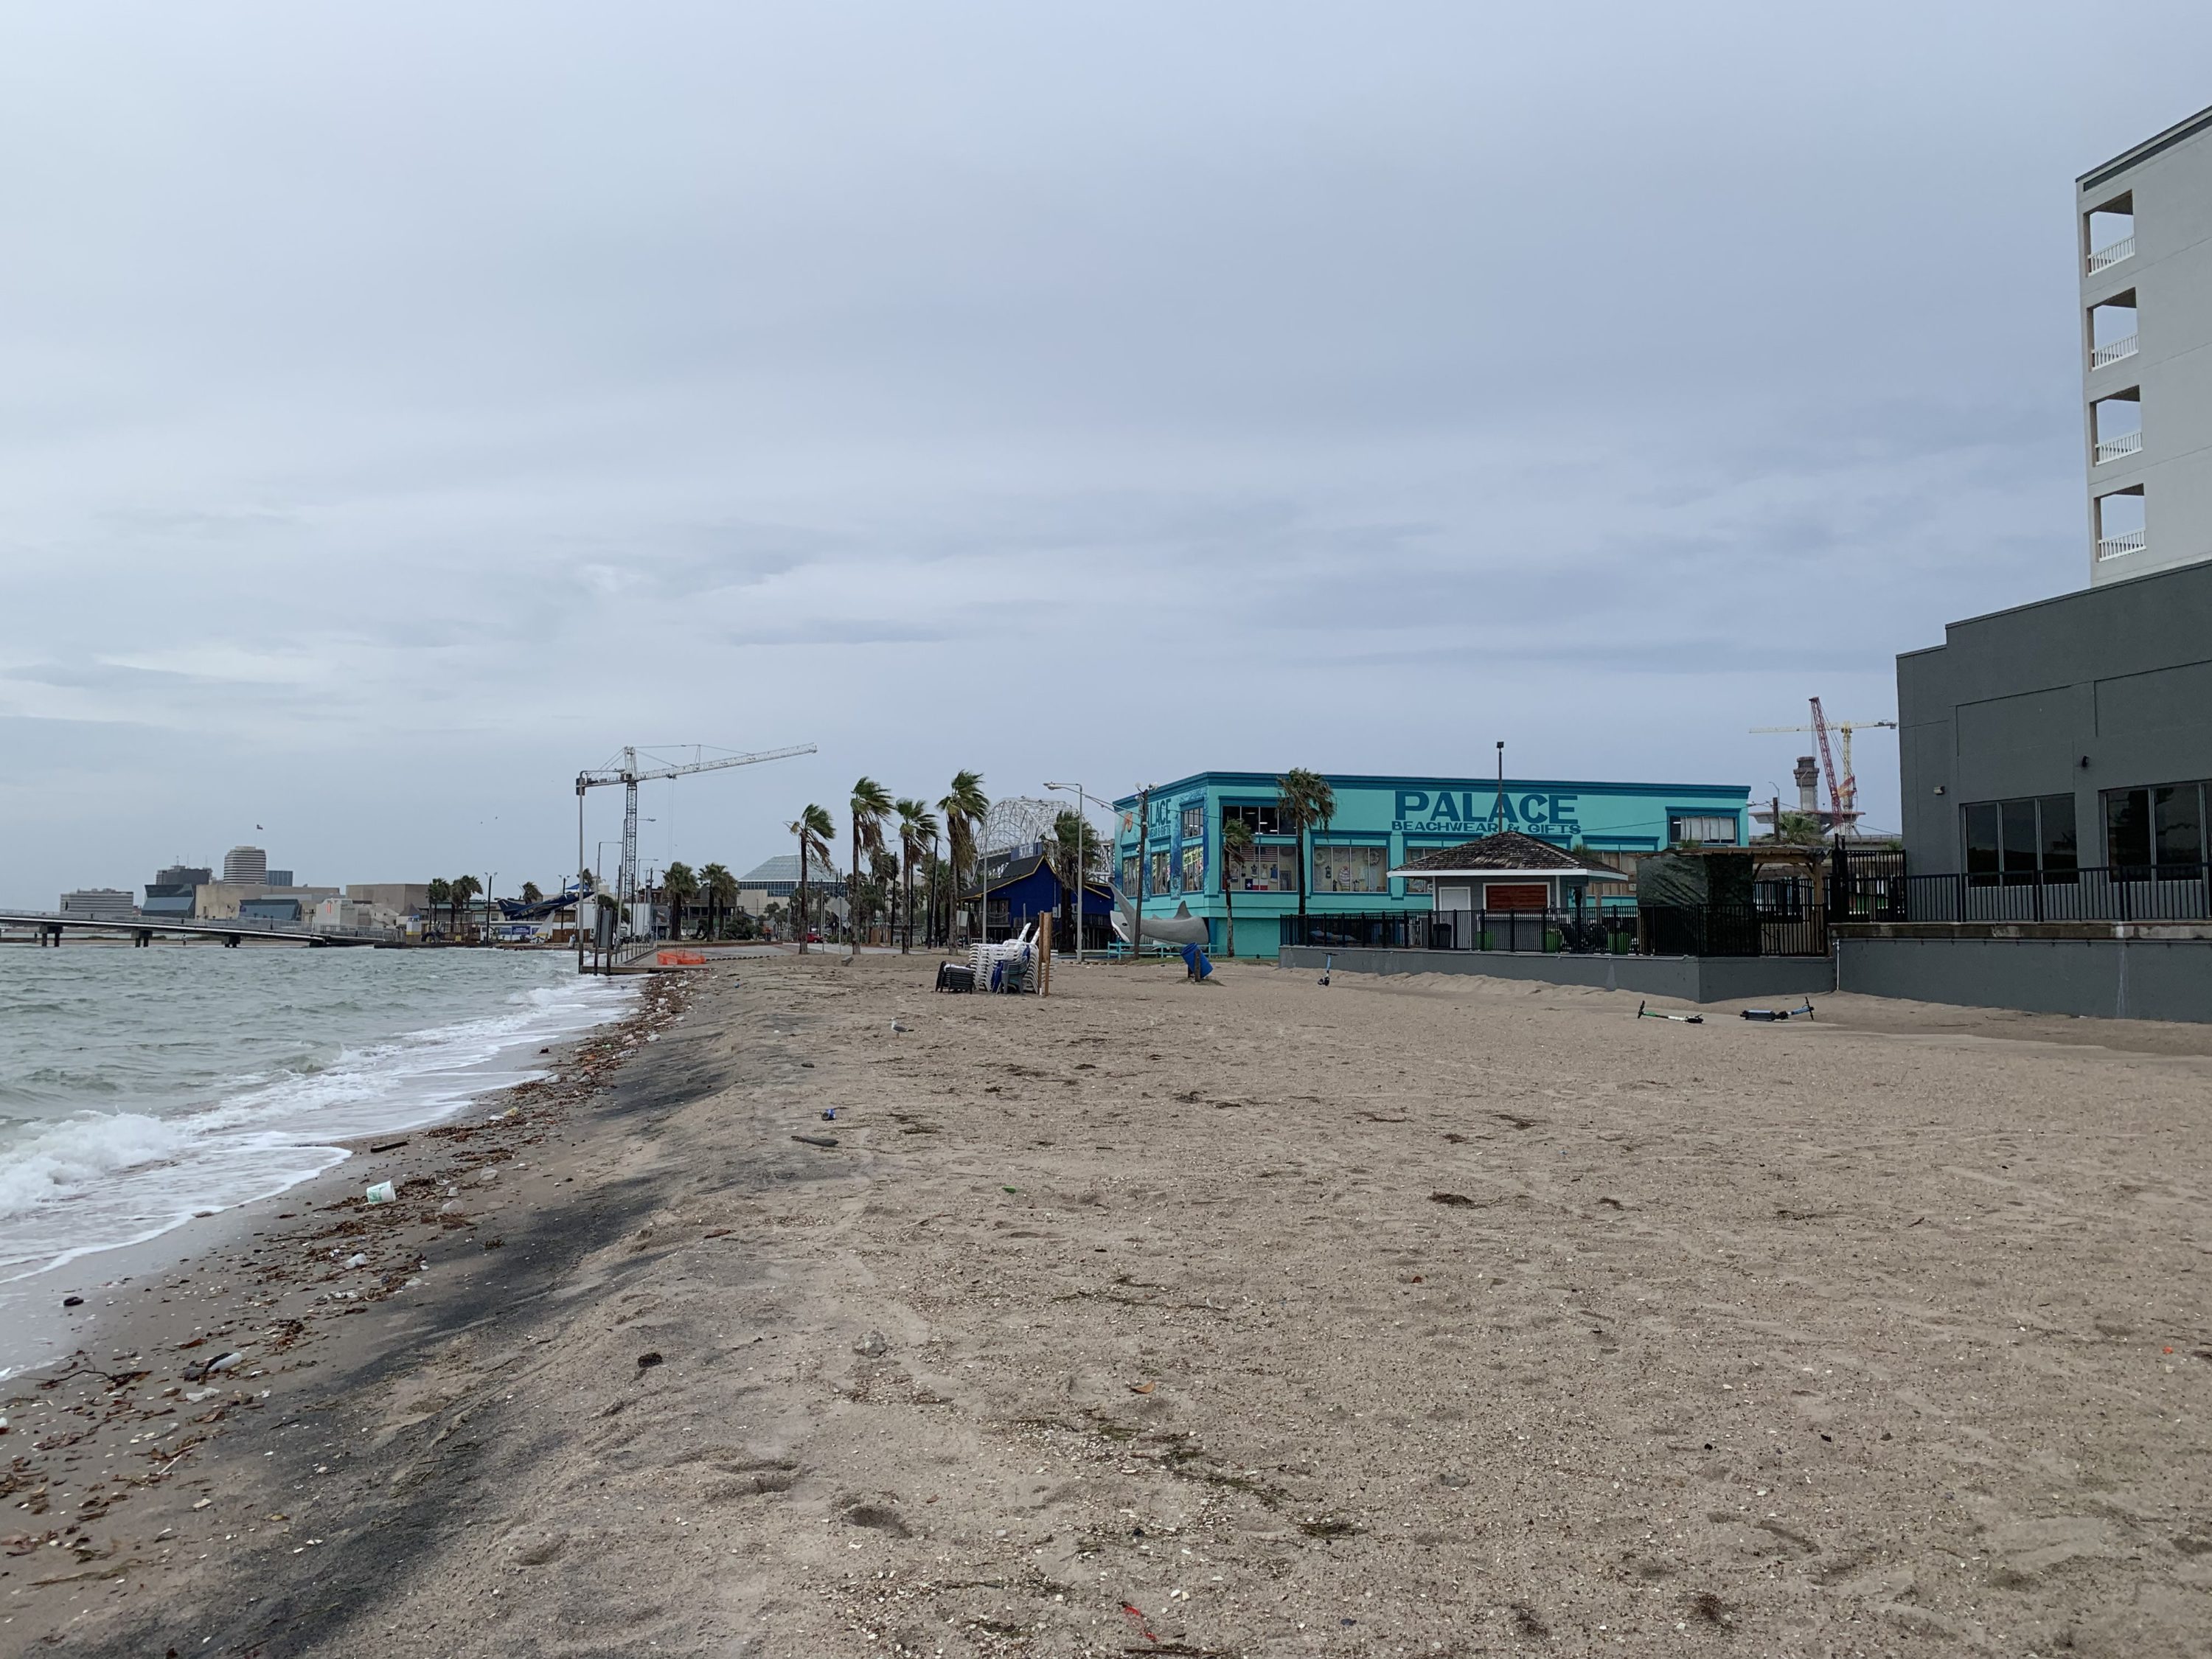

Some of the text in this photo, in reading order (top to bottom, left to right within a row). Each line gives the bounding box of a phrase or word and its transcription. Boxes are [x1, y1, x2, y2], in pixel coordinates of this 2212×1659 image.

[1138, 798, 1172, 828] ALACE
[1395, 790, 1578, 824] PALACE
[1391, 821, 1581, 835] BEACHWEAR & GIFTS
